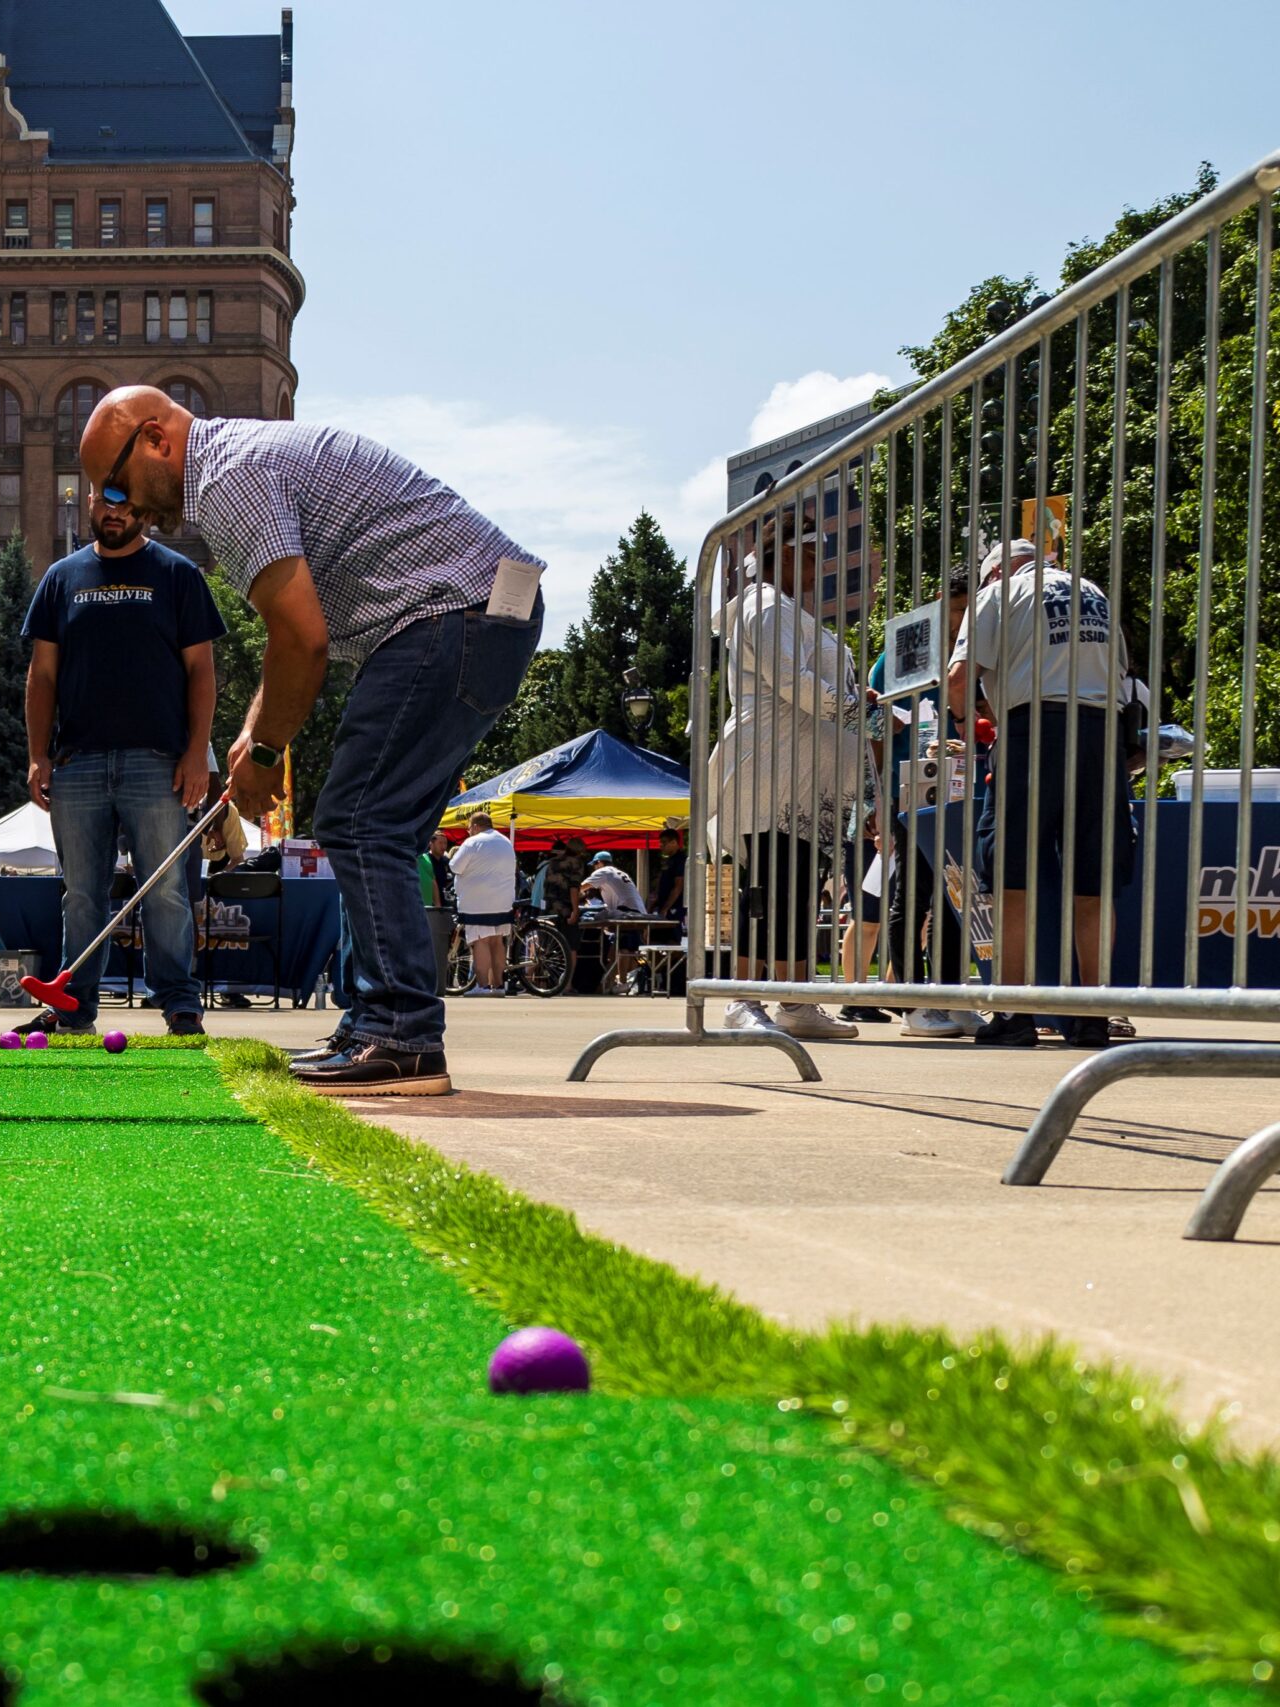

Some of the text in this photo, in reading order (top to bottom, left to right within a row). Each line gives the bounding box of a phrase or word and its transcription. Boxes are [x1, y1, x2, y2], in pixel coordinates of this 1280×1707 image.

[74, 589, 153, 604] QUIKSILVER
[1044, 590, 1110, 620] mke
[1048, 618, 1109, 630] DOTOW
[1049, 630, 1106, 646] AMSSAD
